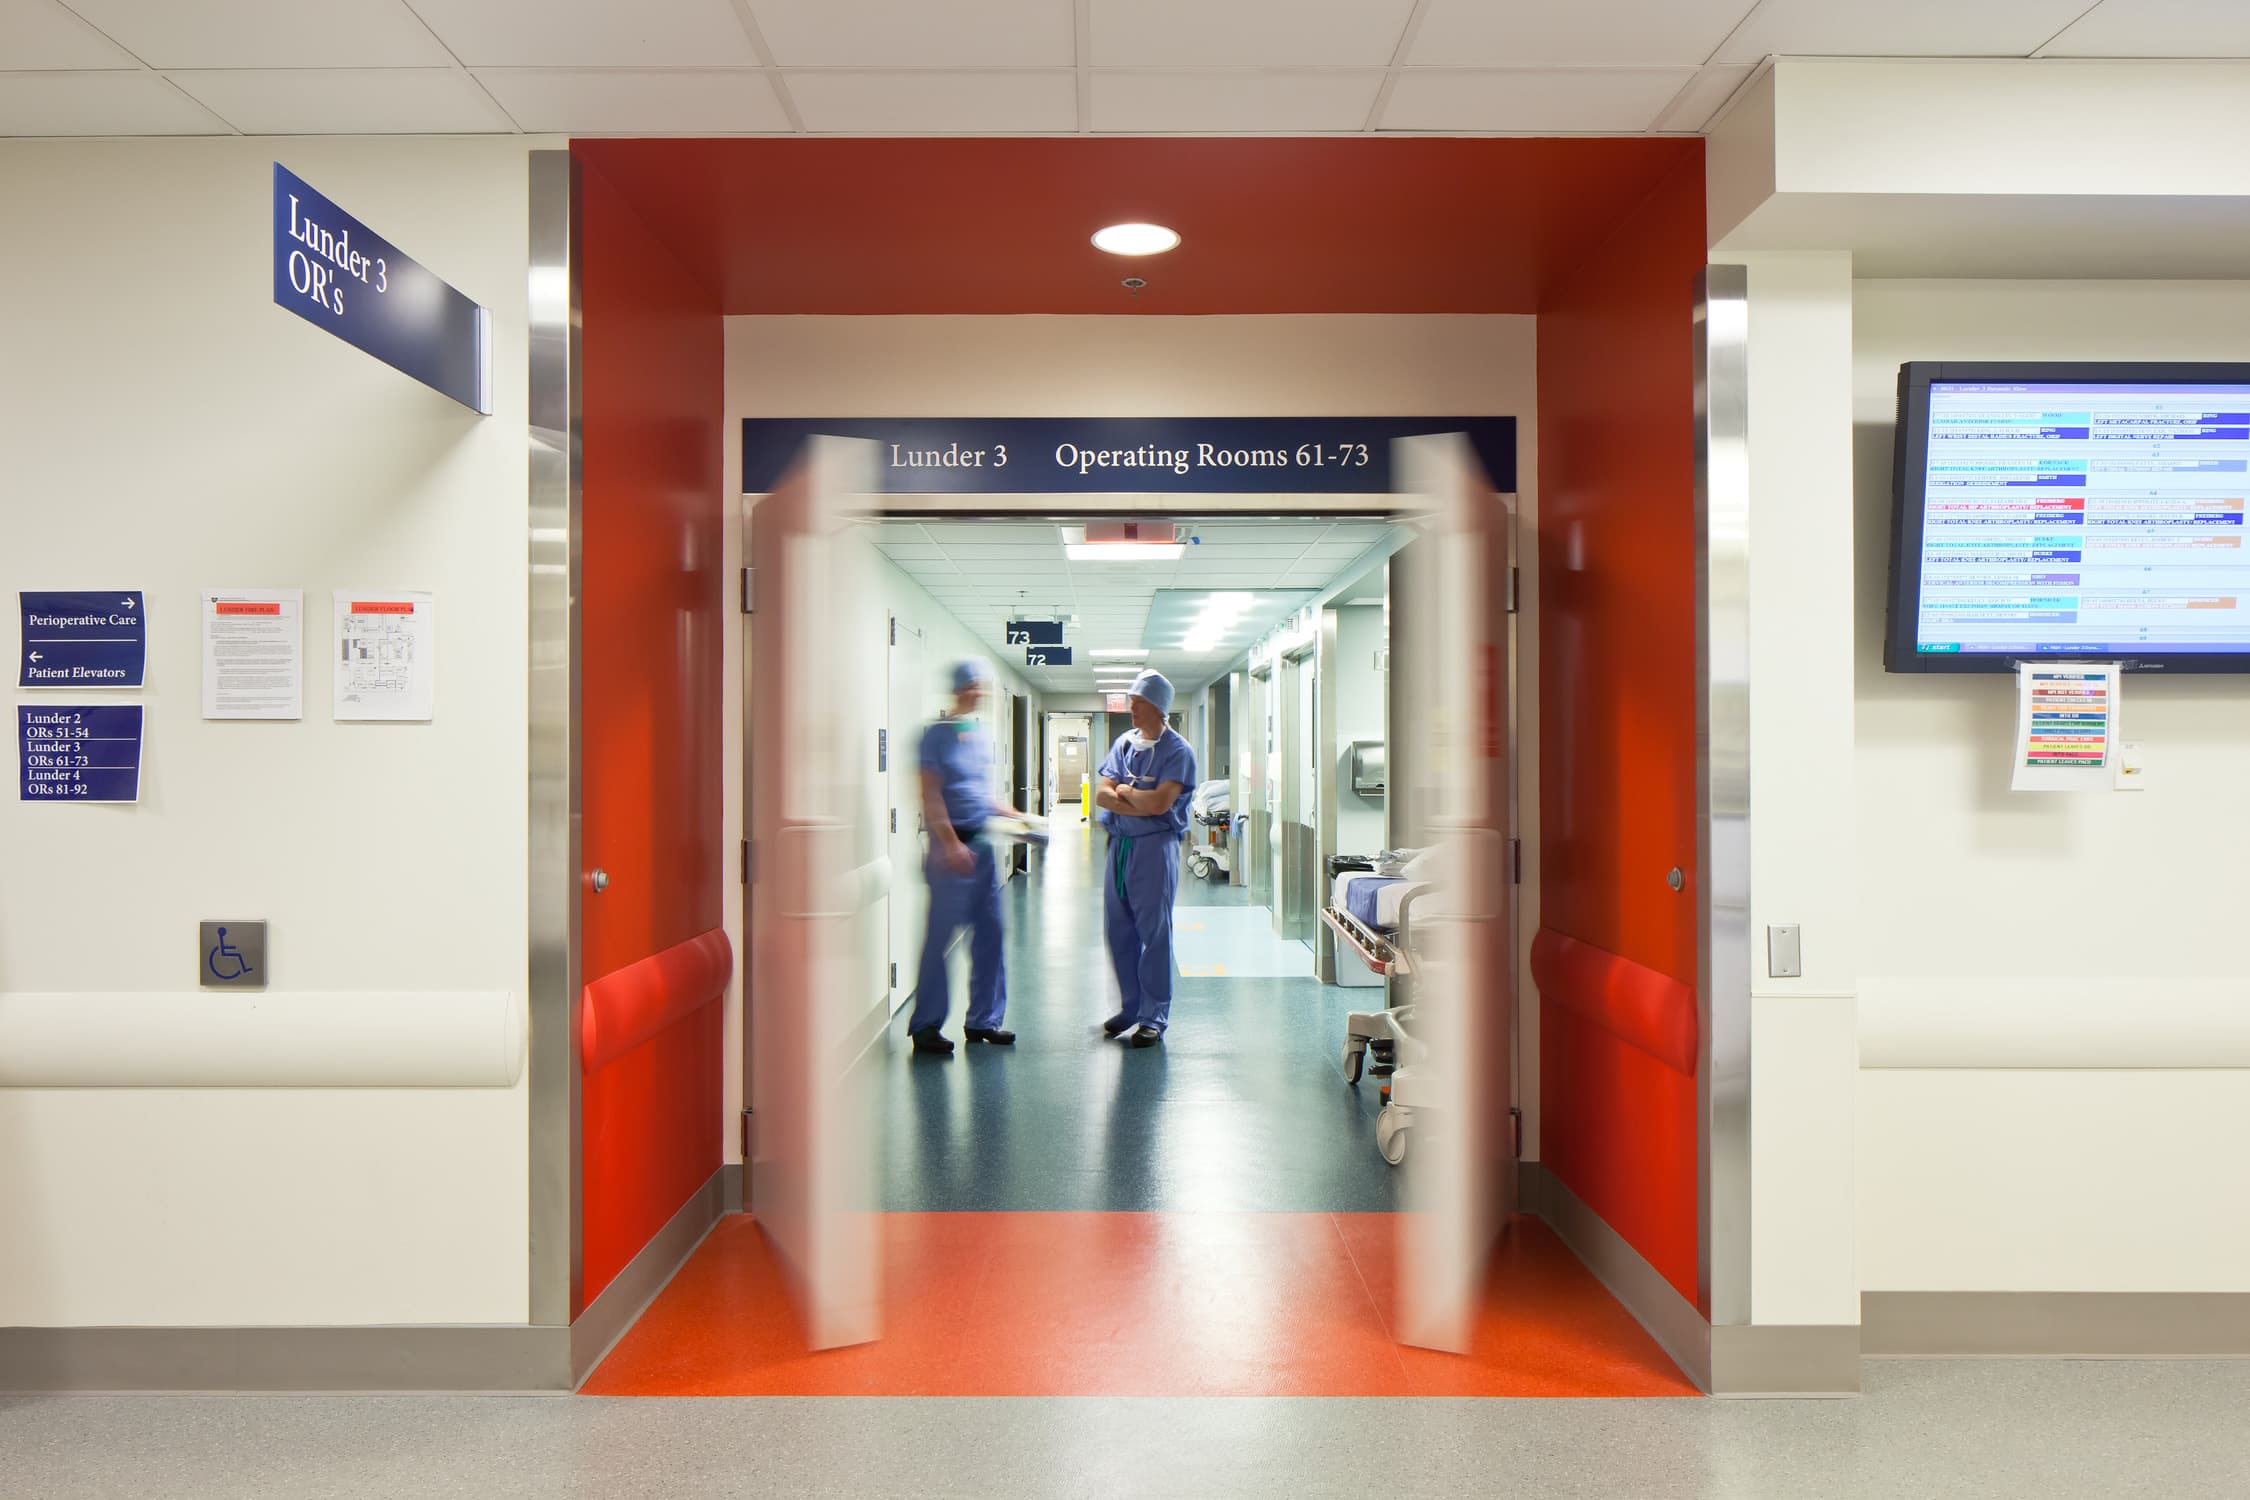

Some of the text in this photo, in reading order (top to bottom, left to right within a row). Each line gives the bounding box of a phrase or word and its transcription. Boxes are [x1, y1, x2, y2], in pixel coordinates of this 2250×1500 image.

[288, 193, 388, 293] Lunder 3
[288, 250, 344, 316] OR's
[890, 442, 1008, 468] Lunder 3
[1055, 443, 1369, 475] Operating Rooms 61-73
[29, 614, 137, 629] Perioperative Care
[1008, 630, 1031, 645] 73
[1027, 653, 1047, 666] 72
[28, 666, 126, 679] Patient Elevators
[27, 712, 81, 724] Lunder 2
[27, 726, 89, 738] ORs 51-54
[27, 740, 81, 752] Lunder 3
[27, 755, 89, 767] ORs 61-73
[28, 769, 81, 781] Lunder 4
[28, 783, 89, 795] ORs 81-92
